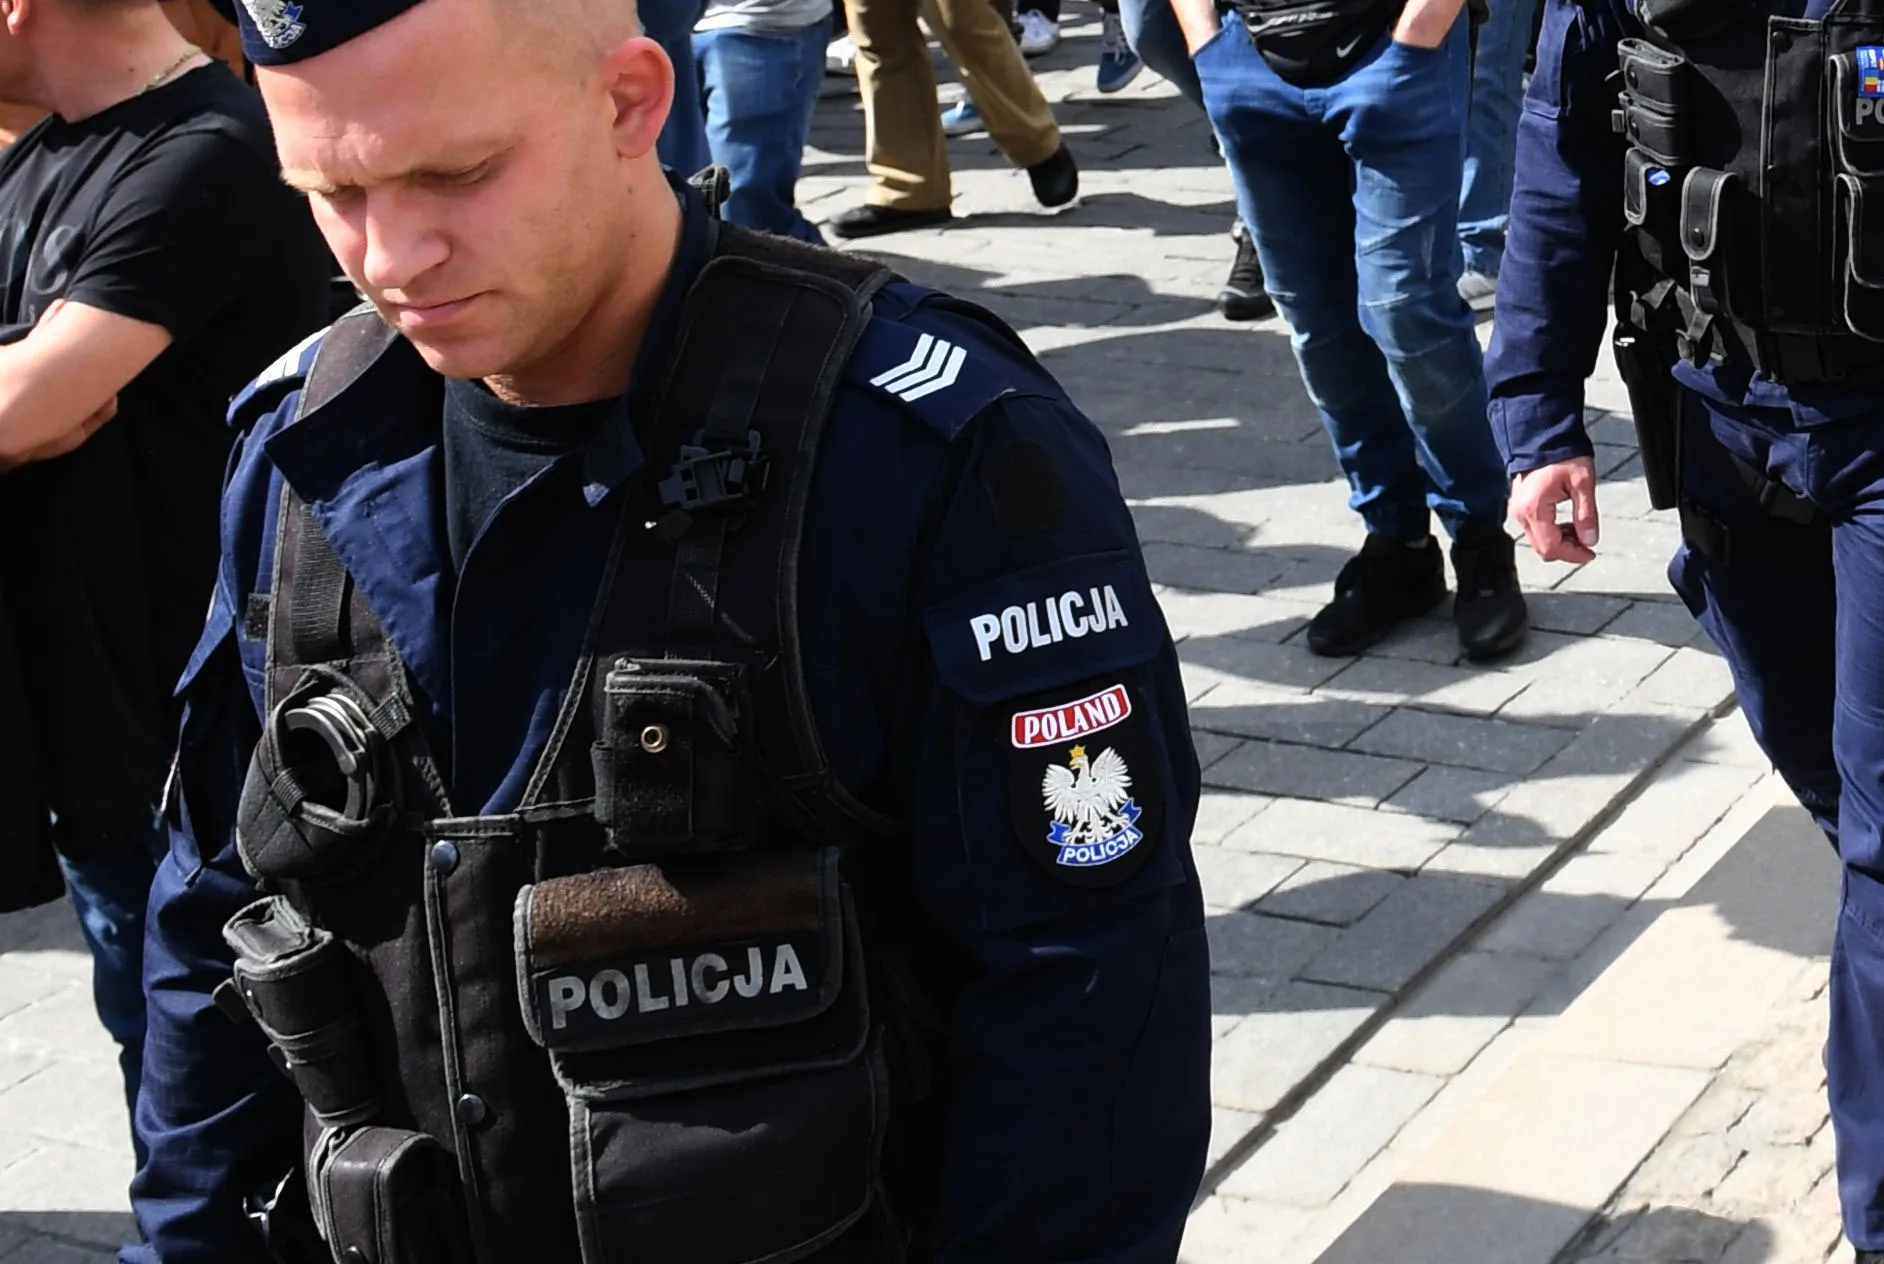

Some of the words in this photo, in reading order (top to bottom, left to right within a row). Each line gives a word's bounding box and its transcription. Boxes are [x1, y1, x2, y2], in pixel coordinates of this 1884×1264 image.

[970, 585, 1129, 661] POLICJA
[1023, 692, 1122, 744] POLAND
[1062, 829, 1140, 864] POLICJA
[548, 944, 808, 1030] POLICJA
